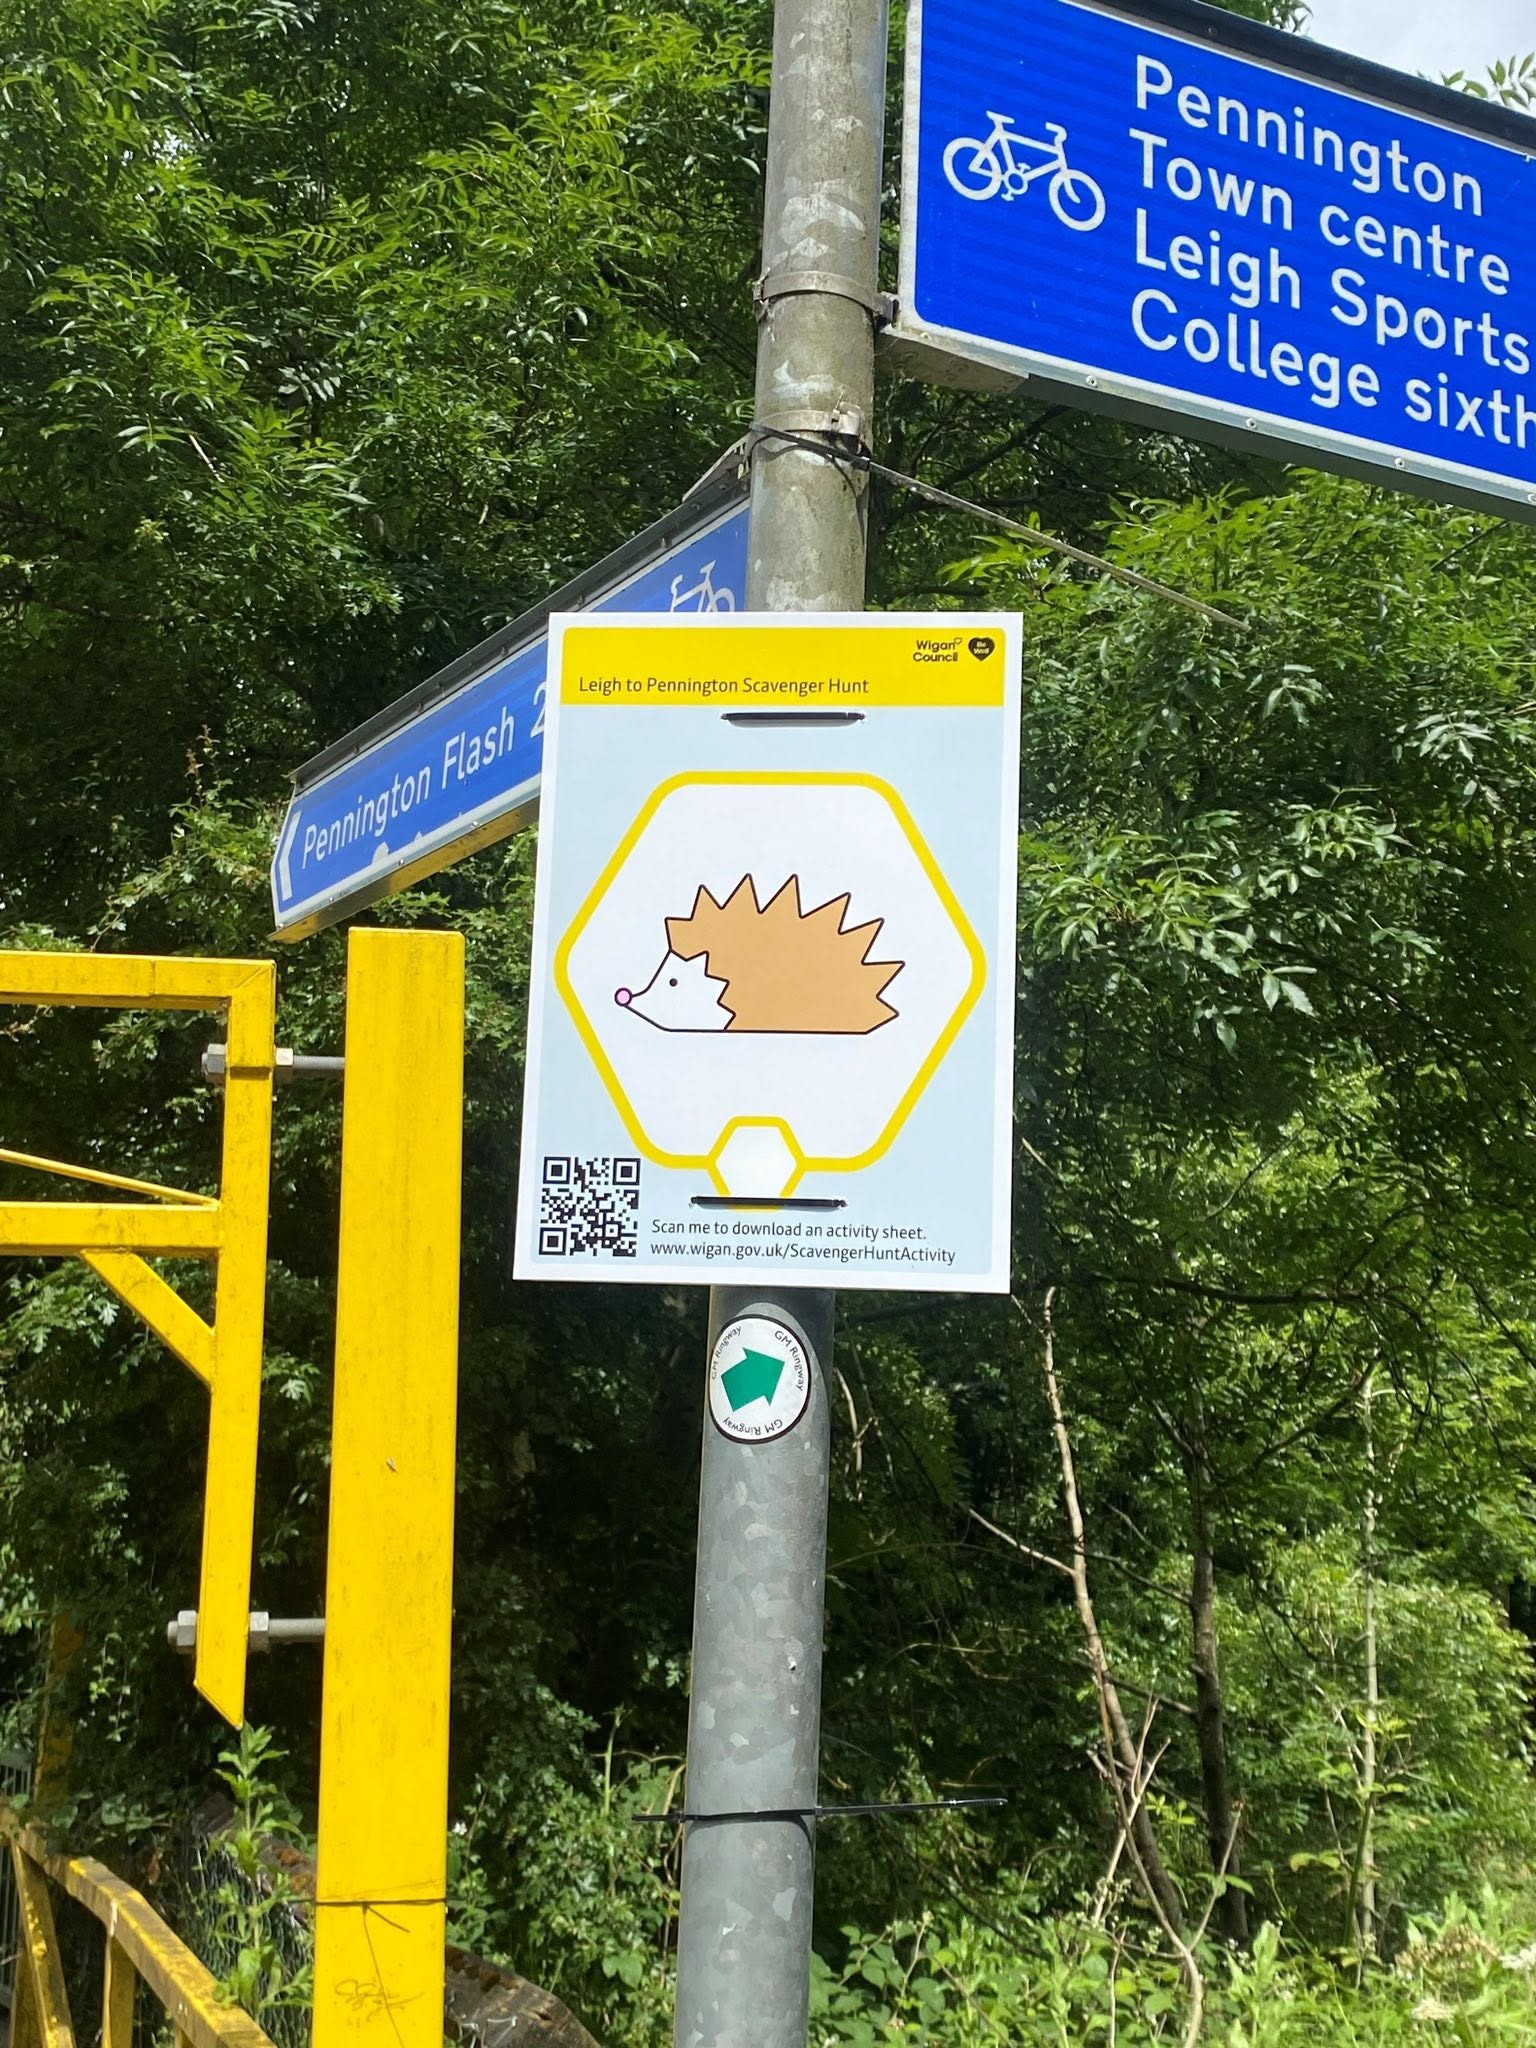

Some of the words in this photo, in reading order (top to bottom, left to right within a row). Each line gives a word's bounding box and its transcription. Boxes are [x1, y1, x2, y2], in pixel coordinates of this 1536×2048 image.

[1135, 54, 1483, 217] Pennington
[1129, 127, 1293, 231] Town
[1319, 205, 1510, 296] centre
[1135, 208, 1301, 311] Leigh
[1330, 268, 1530, 375] Sports
[1131, 288, 1380, 409] College
[1404, 372, 1536, 449] sixth
[913, 652, 958, 662] Council
[916, 640, 955, 653] Wigan
[579, 676, 622, 696] Leigh
[626, 679, 643, 693] to
[647, 677, 738, 697] Pennington
[742, 678, 824, 698] Scavenger
[828, 678, 870, 694] Hunt
[302, 764, 430, 870] Pennington
[442, 706, 514, 791] Flash
[651, 1219, 685, 1234] Scan
[688, 1223, 711, 1235] me
[714, 1221, 729, 1235] to
[732, 1221, 802, 1237] download
[805, 1226, 823, 1238] an
[826, 1223, 879, 1242] activity
[882, 1225, 927, 1240] sheet.
[651, 1240, 956, 1265] www.wigan.gov.uk/ScavengerHuntActivity
[711, 1362, 718, 1380] GM
[716, 1326, 742, 1359] Ringway
[774, 1330, 792, 1347] GM
[789, 1346, 804, 1391] Ringway
[723, 1417, 761, 1435] Ringway
[765, 1419, 783, 1433] GM
